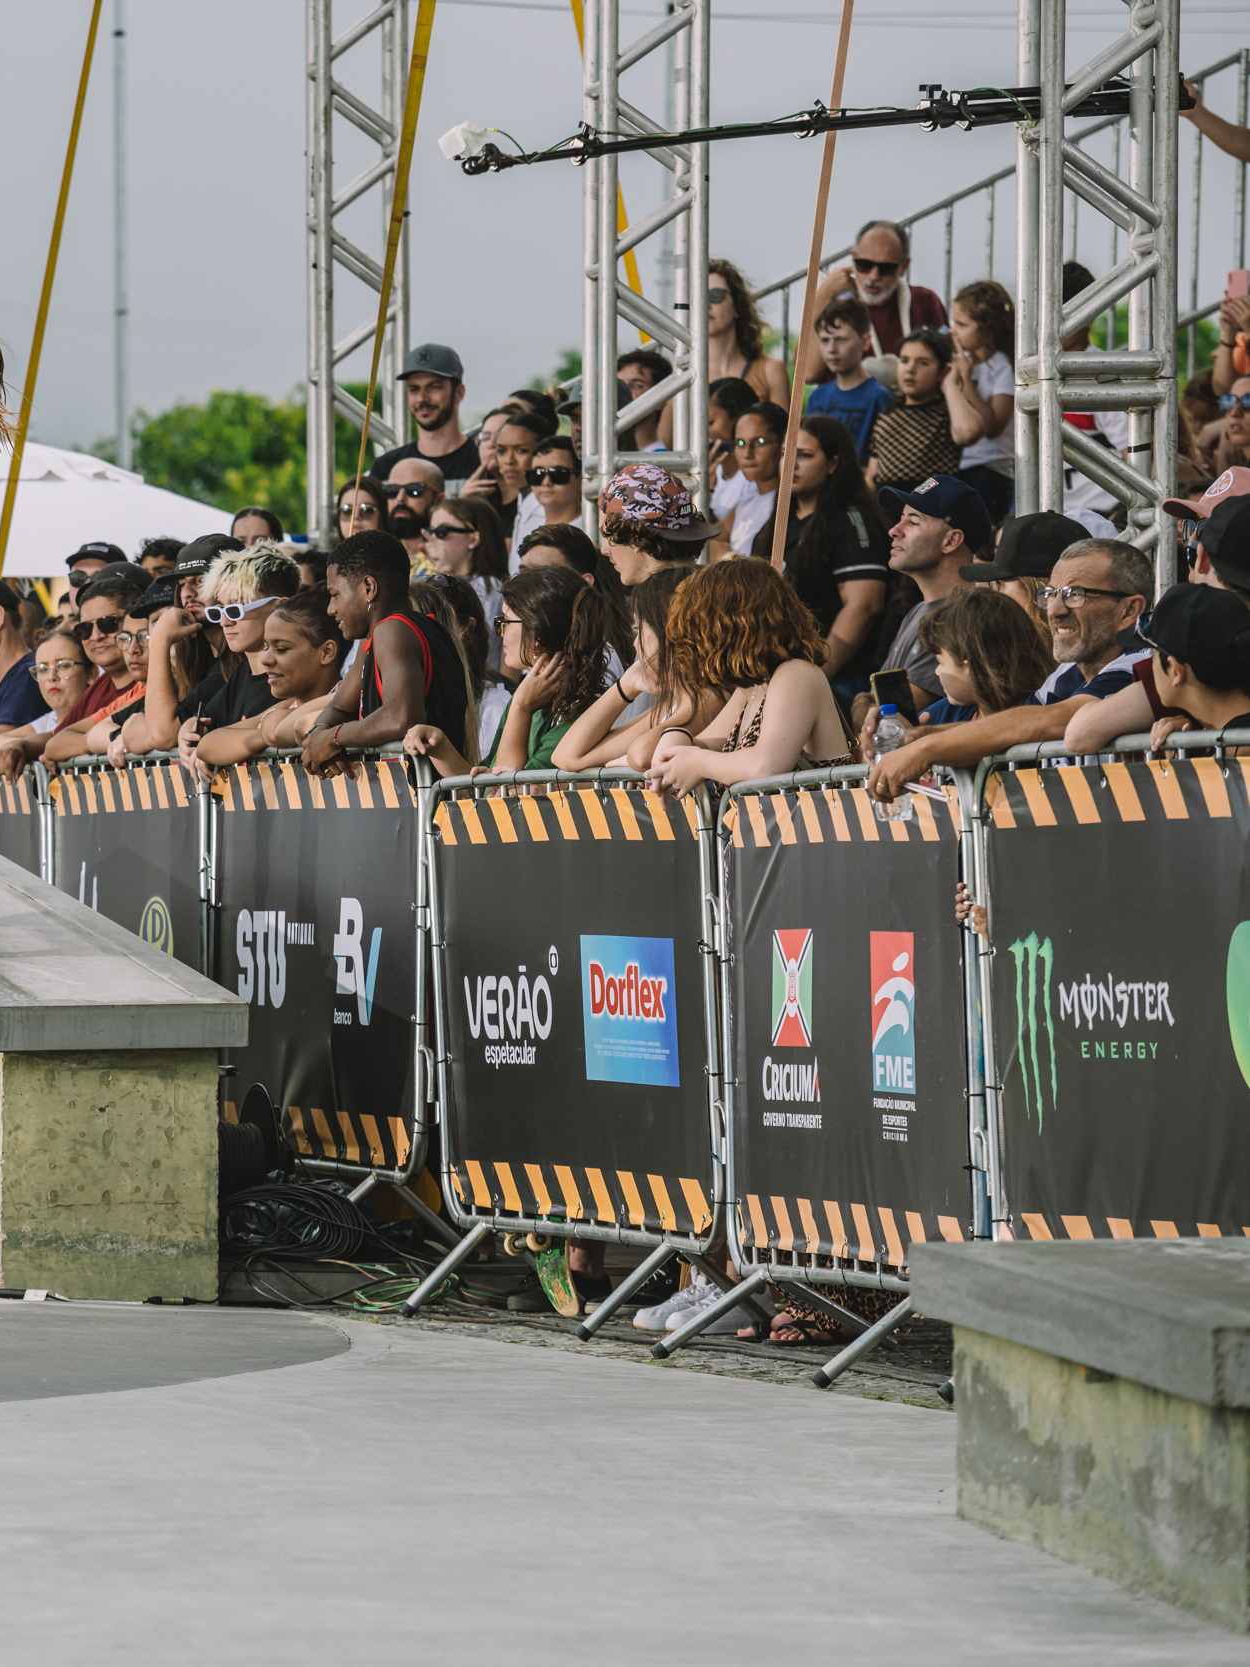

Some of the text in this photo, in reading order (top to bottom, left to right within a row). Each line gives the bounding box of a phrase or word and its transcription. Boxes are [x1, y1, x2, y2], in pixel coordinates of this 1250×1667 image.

[236, 908, 287, 1009] STU
[287, 922, 315, 946] NATIONAL
[1058, 972, 1175, 1031] MONSTER
[333, 1007, 353, 1025] banco
[485, 1040, 536, 1070] espetacular
[1081, 1041, 1159, 1059] ENERGY
[875, 1054, 914, 1089] FME
[873, 1096, 917, 1112] FUNDAÇÃO MUNICIPAL
[762, 1112, 823, 1129] GOVERNO TRANSPARENTE
